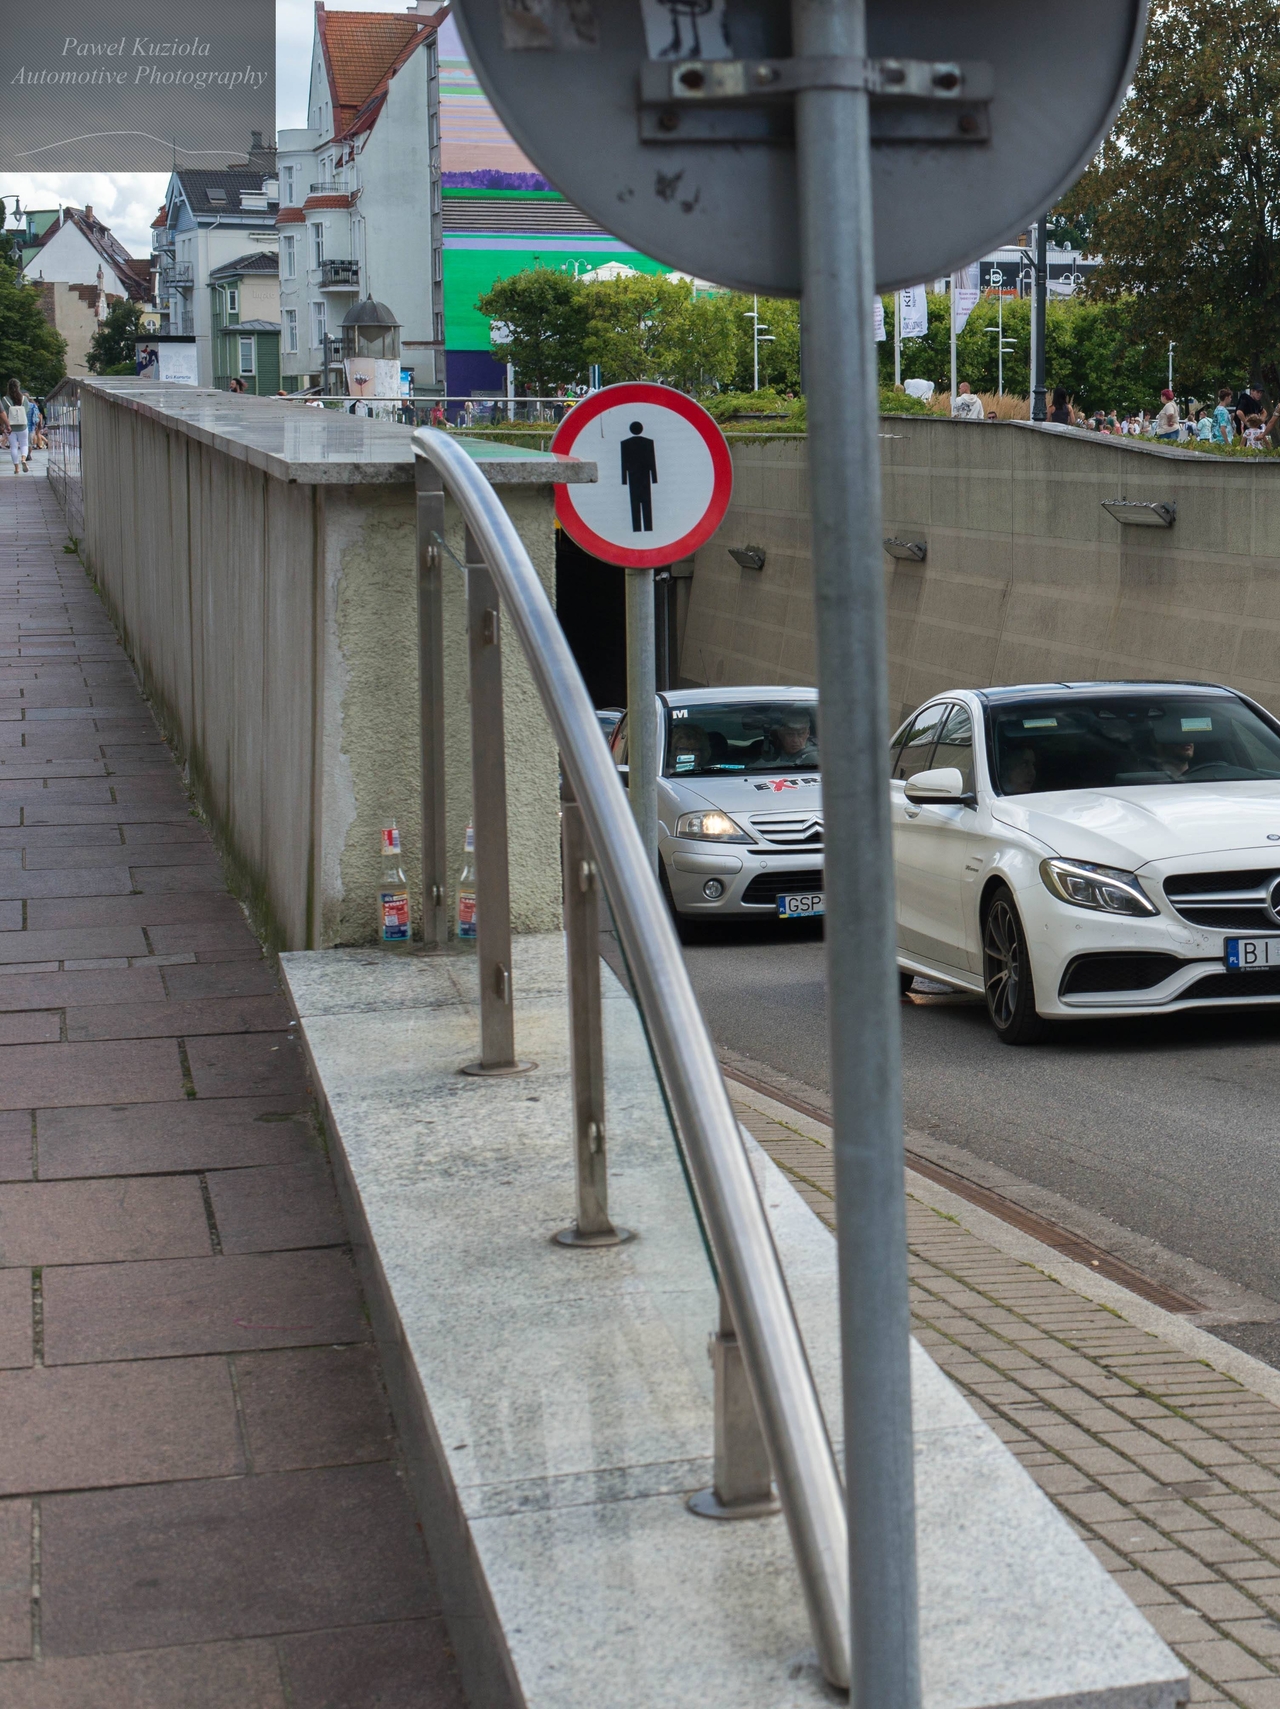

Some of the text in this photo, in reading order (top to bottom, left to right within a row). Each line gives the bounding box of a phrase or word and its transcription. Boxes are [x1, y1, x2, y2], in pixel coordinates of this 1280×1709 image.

[672, 709, 688, 719] M
[753, 778, 823, 793] EXTR
[788, 895, 822, 913] GSP
[1244, 941, 1269, 965] BI
